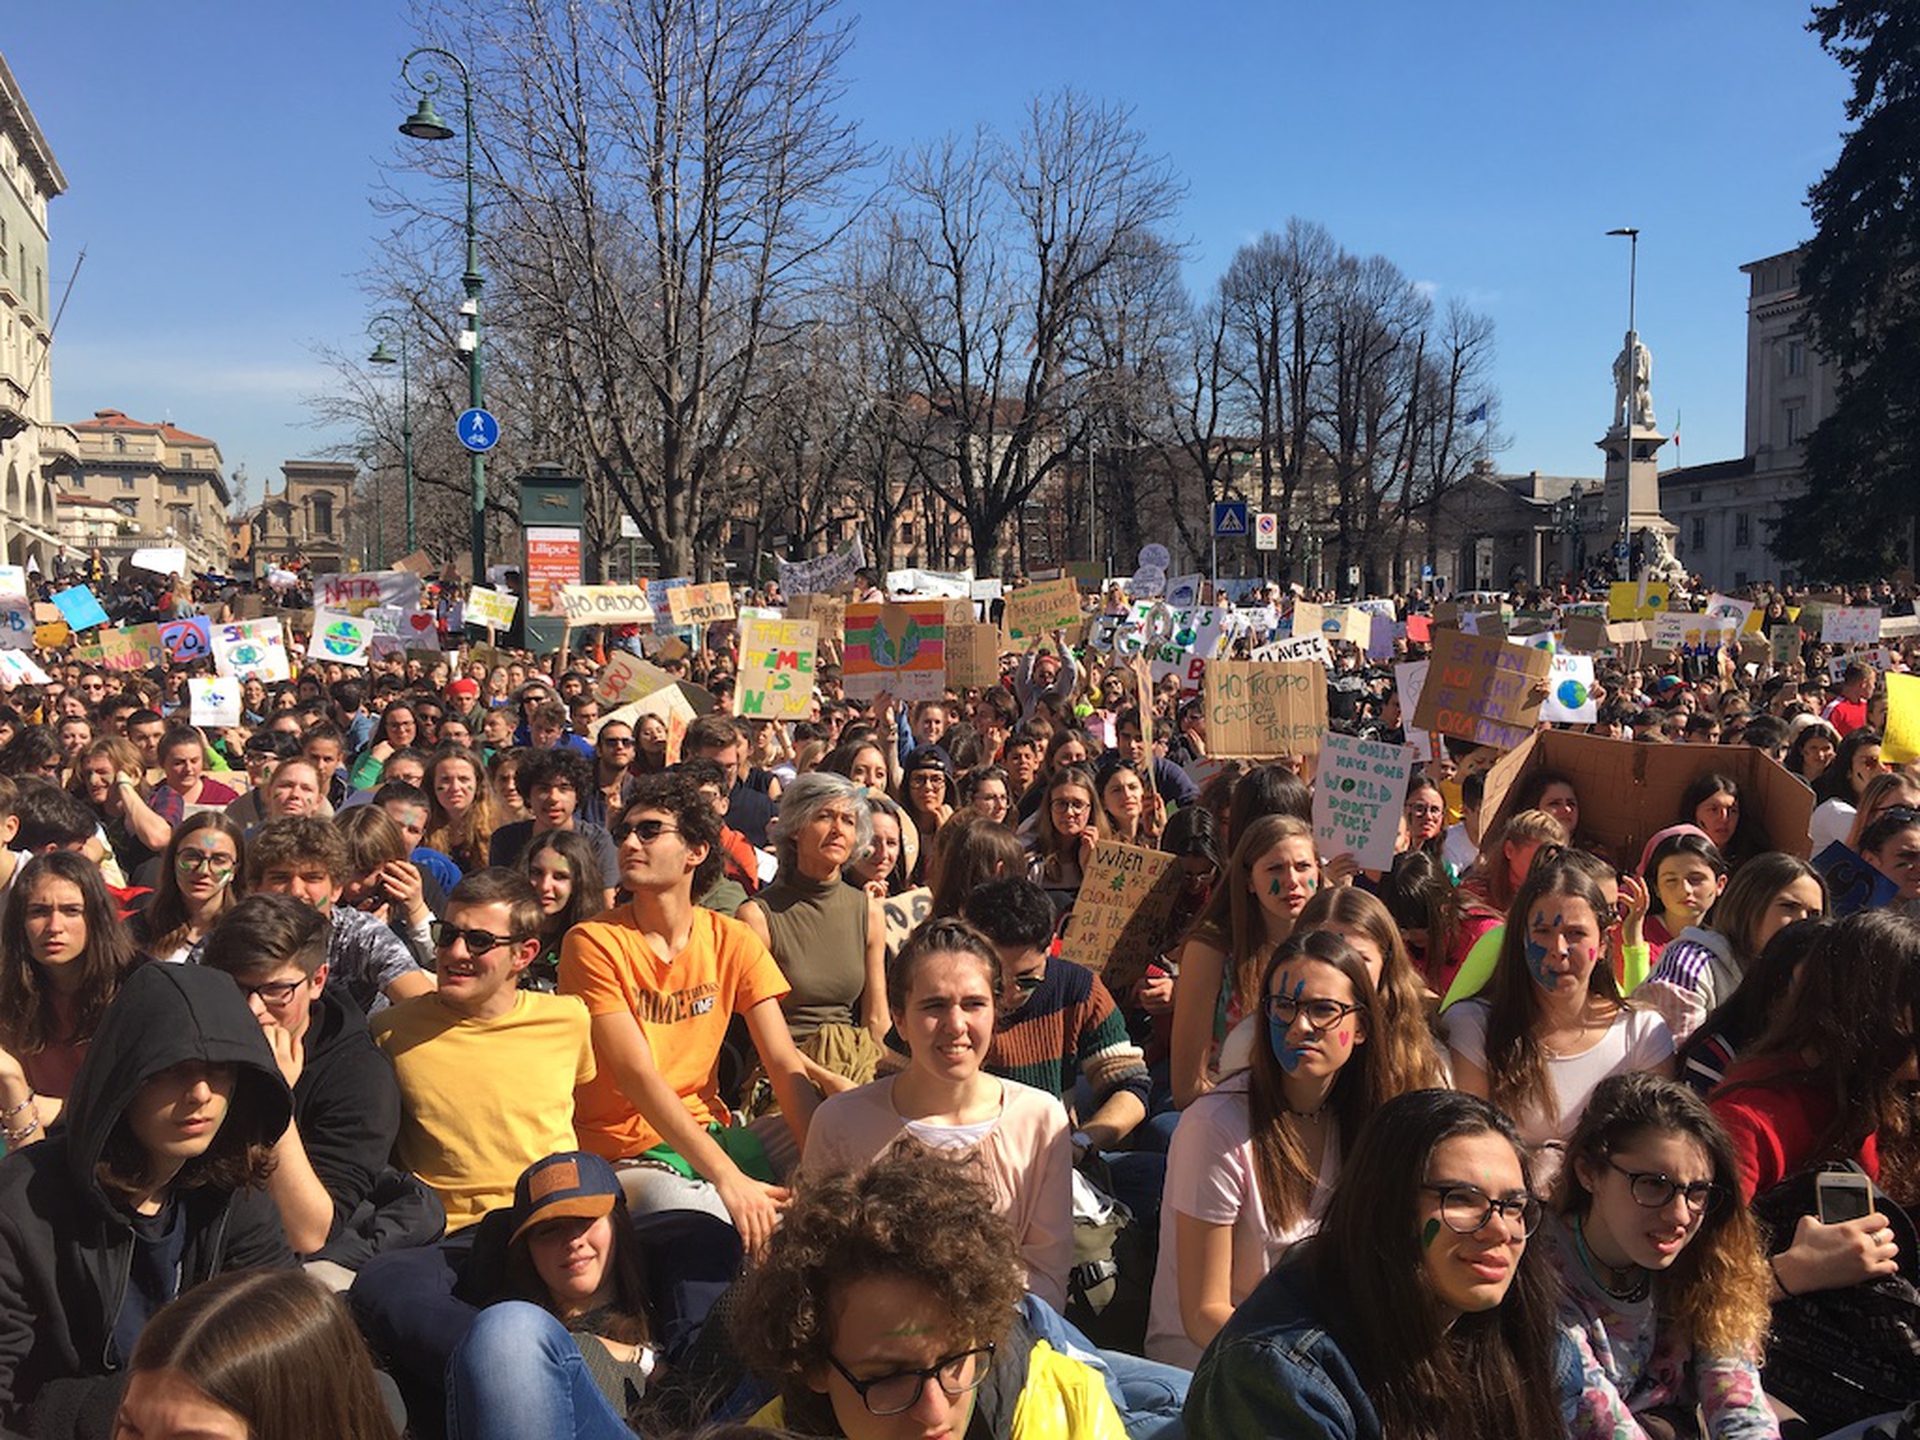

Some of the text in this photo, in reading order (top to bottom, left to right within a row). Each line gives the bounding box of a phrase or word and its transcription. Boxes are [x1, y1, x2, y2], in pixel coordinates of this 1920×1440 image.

[529, 542, 570, 557] Lilliput
[325, 577, 380, 604] NATTA
[564, 595, 593, 619] HO
[596, 595, 648, 612] CALDO
[223, 625, 261, 642] SAVE
[752, 622, 798, 645] THE
[746, 648, 812, 674] TIME
[766, 670, 792, 690] IS
[1217, 669, 1310, 699] HO TROPPO
[1327, 735, 1401, 761] WE ONLY
[1336, 755, 1404, 779] HAVE ONE
[1333, 812, 1372, 833] FUCK
[1345, 833, 1370, 850] UP
